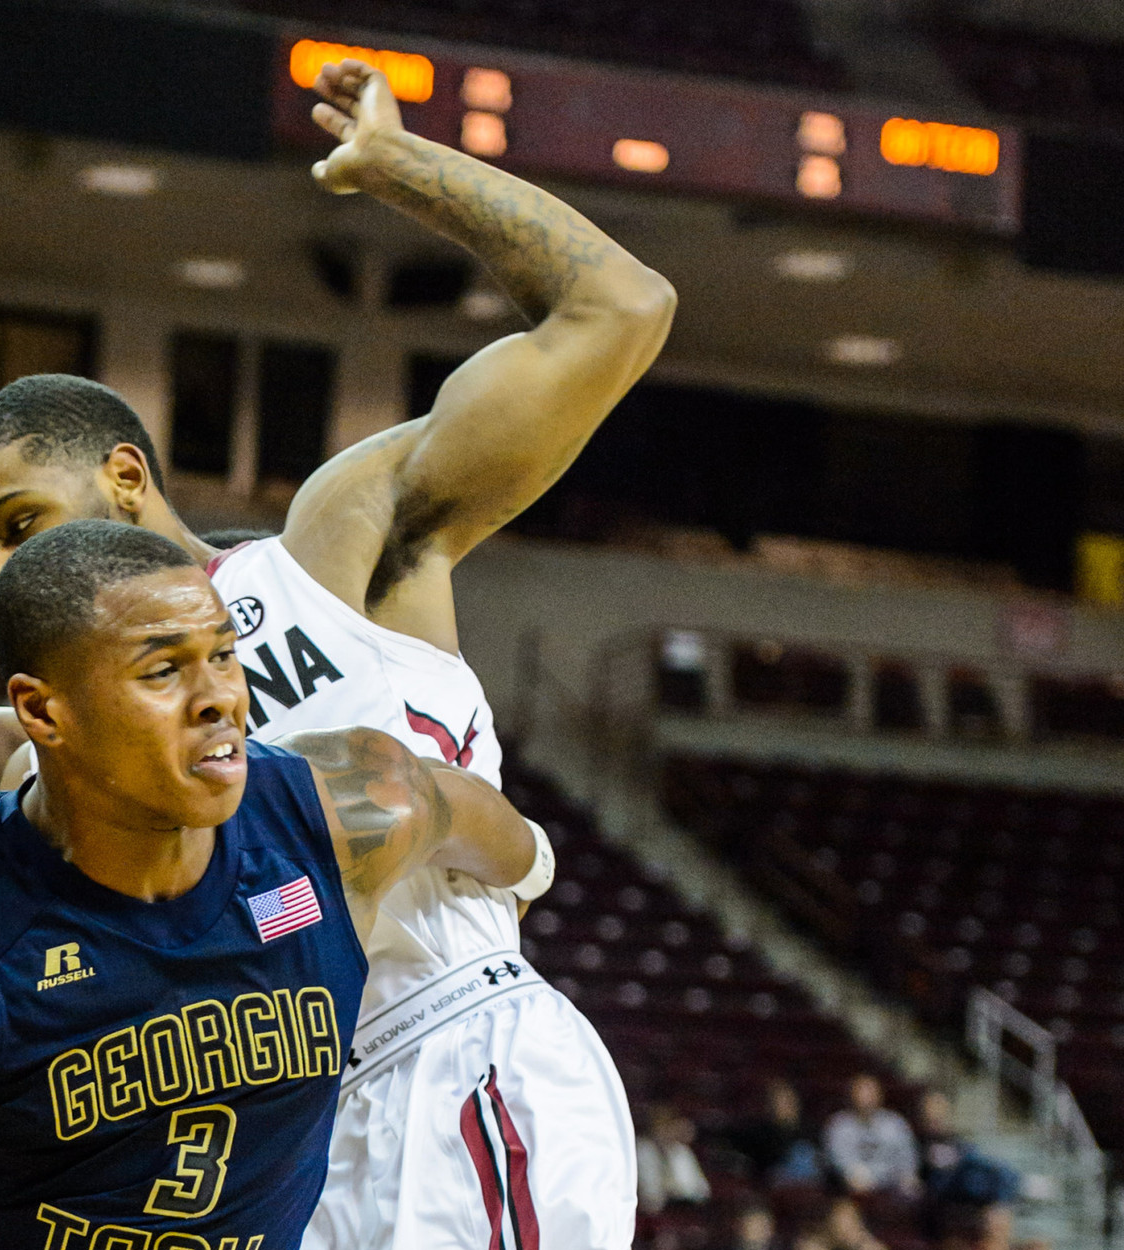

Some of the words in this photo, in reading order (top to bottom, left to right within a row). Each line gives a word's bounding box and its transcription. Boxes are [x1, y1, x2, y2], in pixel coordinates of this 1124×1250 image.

[228, 597, 264, 640] EC
[242, 624, 344, 737] NA
[36, 967, 97, 992] RUSSELL
[44, 941, 81, 977] R
[430, 978, 483, 1013] UNDER
[362, 1008, 426, 1055] ARMOUR
[47, 985, 342, 1142] GEORGIA
[143, 1103, 239, 1219] 3
